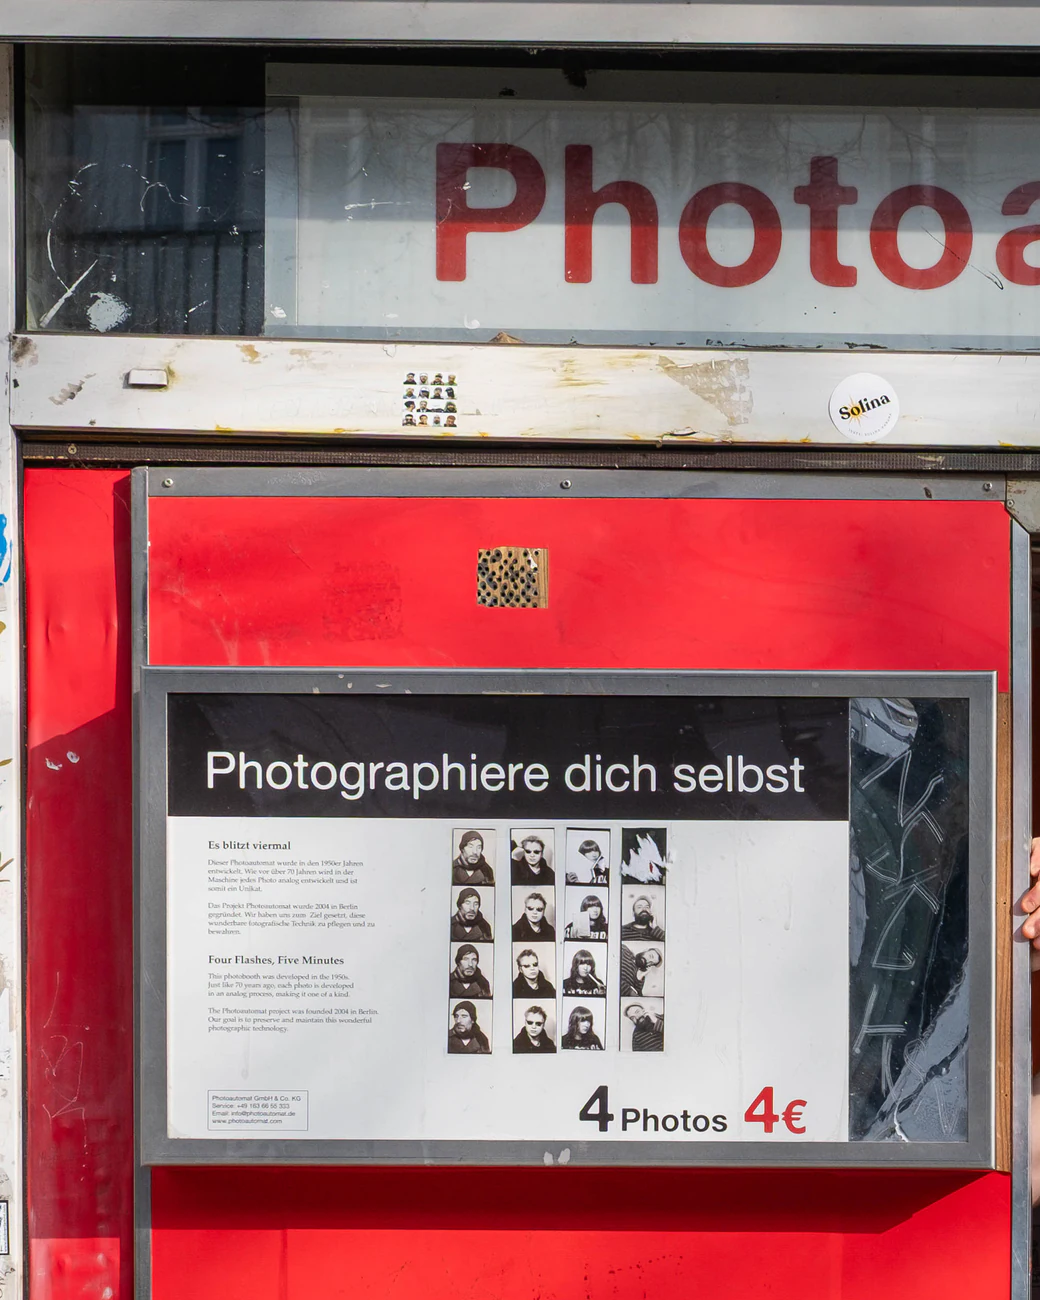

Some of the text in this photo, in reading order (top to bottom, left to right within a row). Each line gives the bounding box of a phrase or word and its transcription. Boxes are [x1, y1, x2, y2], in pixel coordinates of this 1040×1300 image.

[839, 395, 891, 420] Solina
[206, 751, 805, 799] Photographiere dich selbst
[208, 841, 291, 849] Es blitzt viermal
[208, 955, 345, 965] Four Flashes, Five Minutes
[579, 1085, 808, 1134] 4 Photos 4€
